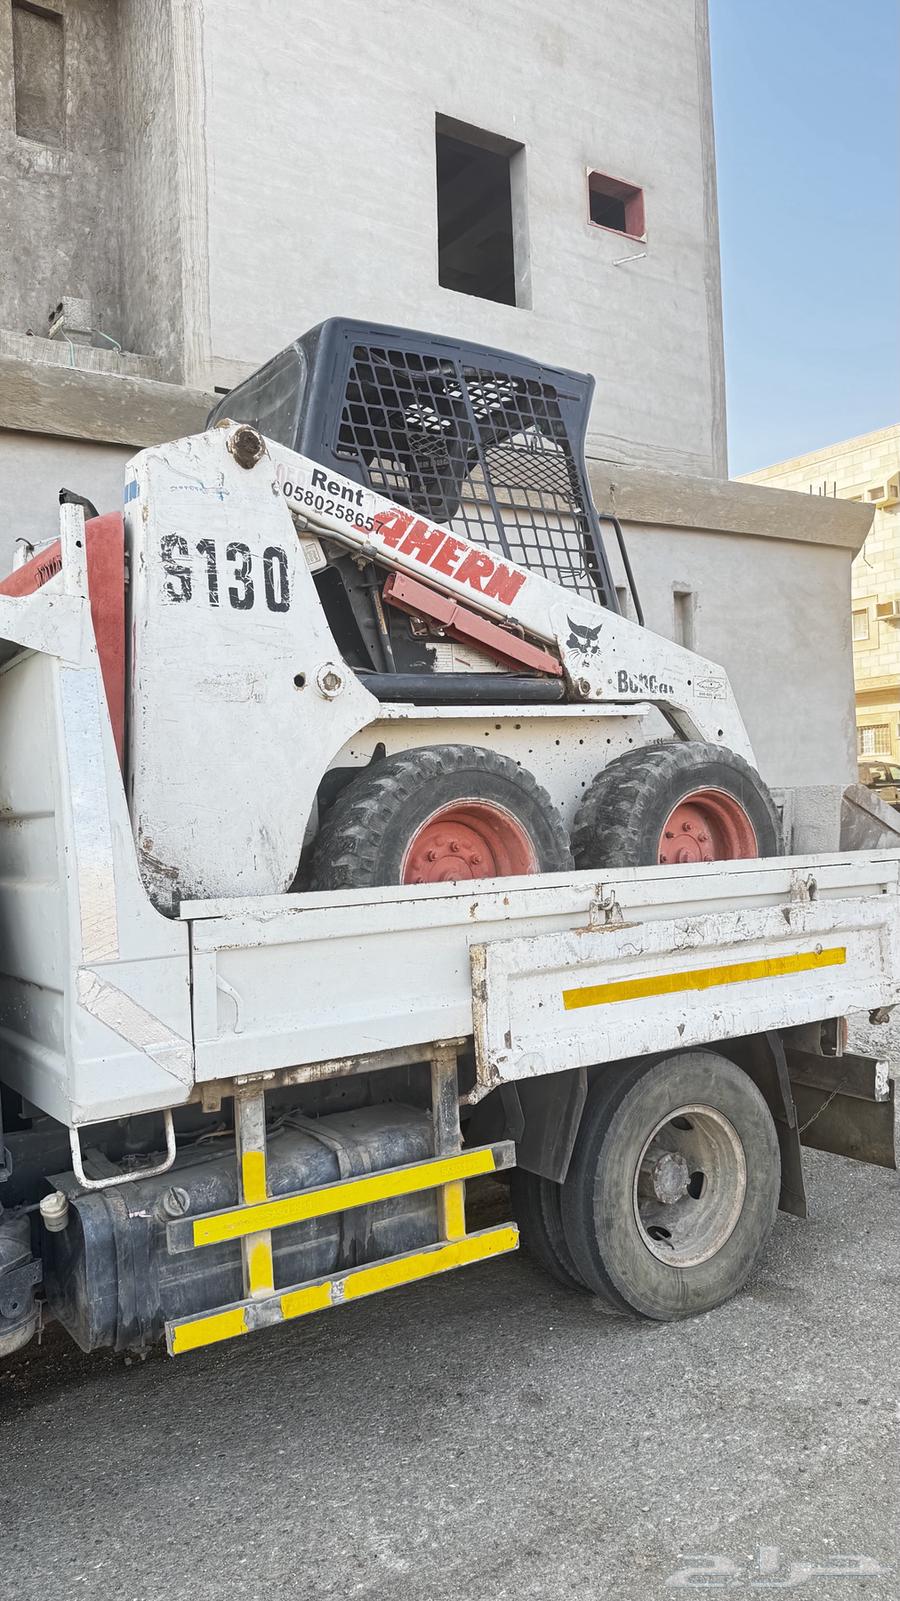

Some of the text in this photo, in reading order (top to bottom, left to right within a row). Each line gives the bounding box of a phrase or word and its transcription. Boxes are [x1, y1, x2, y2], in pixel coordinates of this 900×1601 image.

[283, 482, 384, 534] 0580258657
[312, 469, 364, 507] Rent
[162, 533, 291, 613] S130
[352, 508, 527, 606] AHERN
